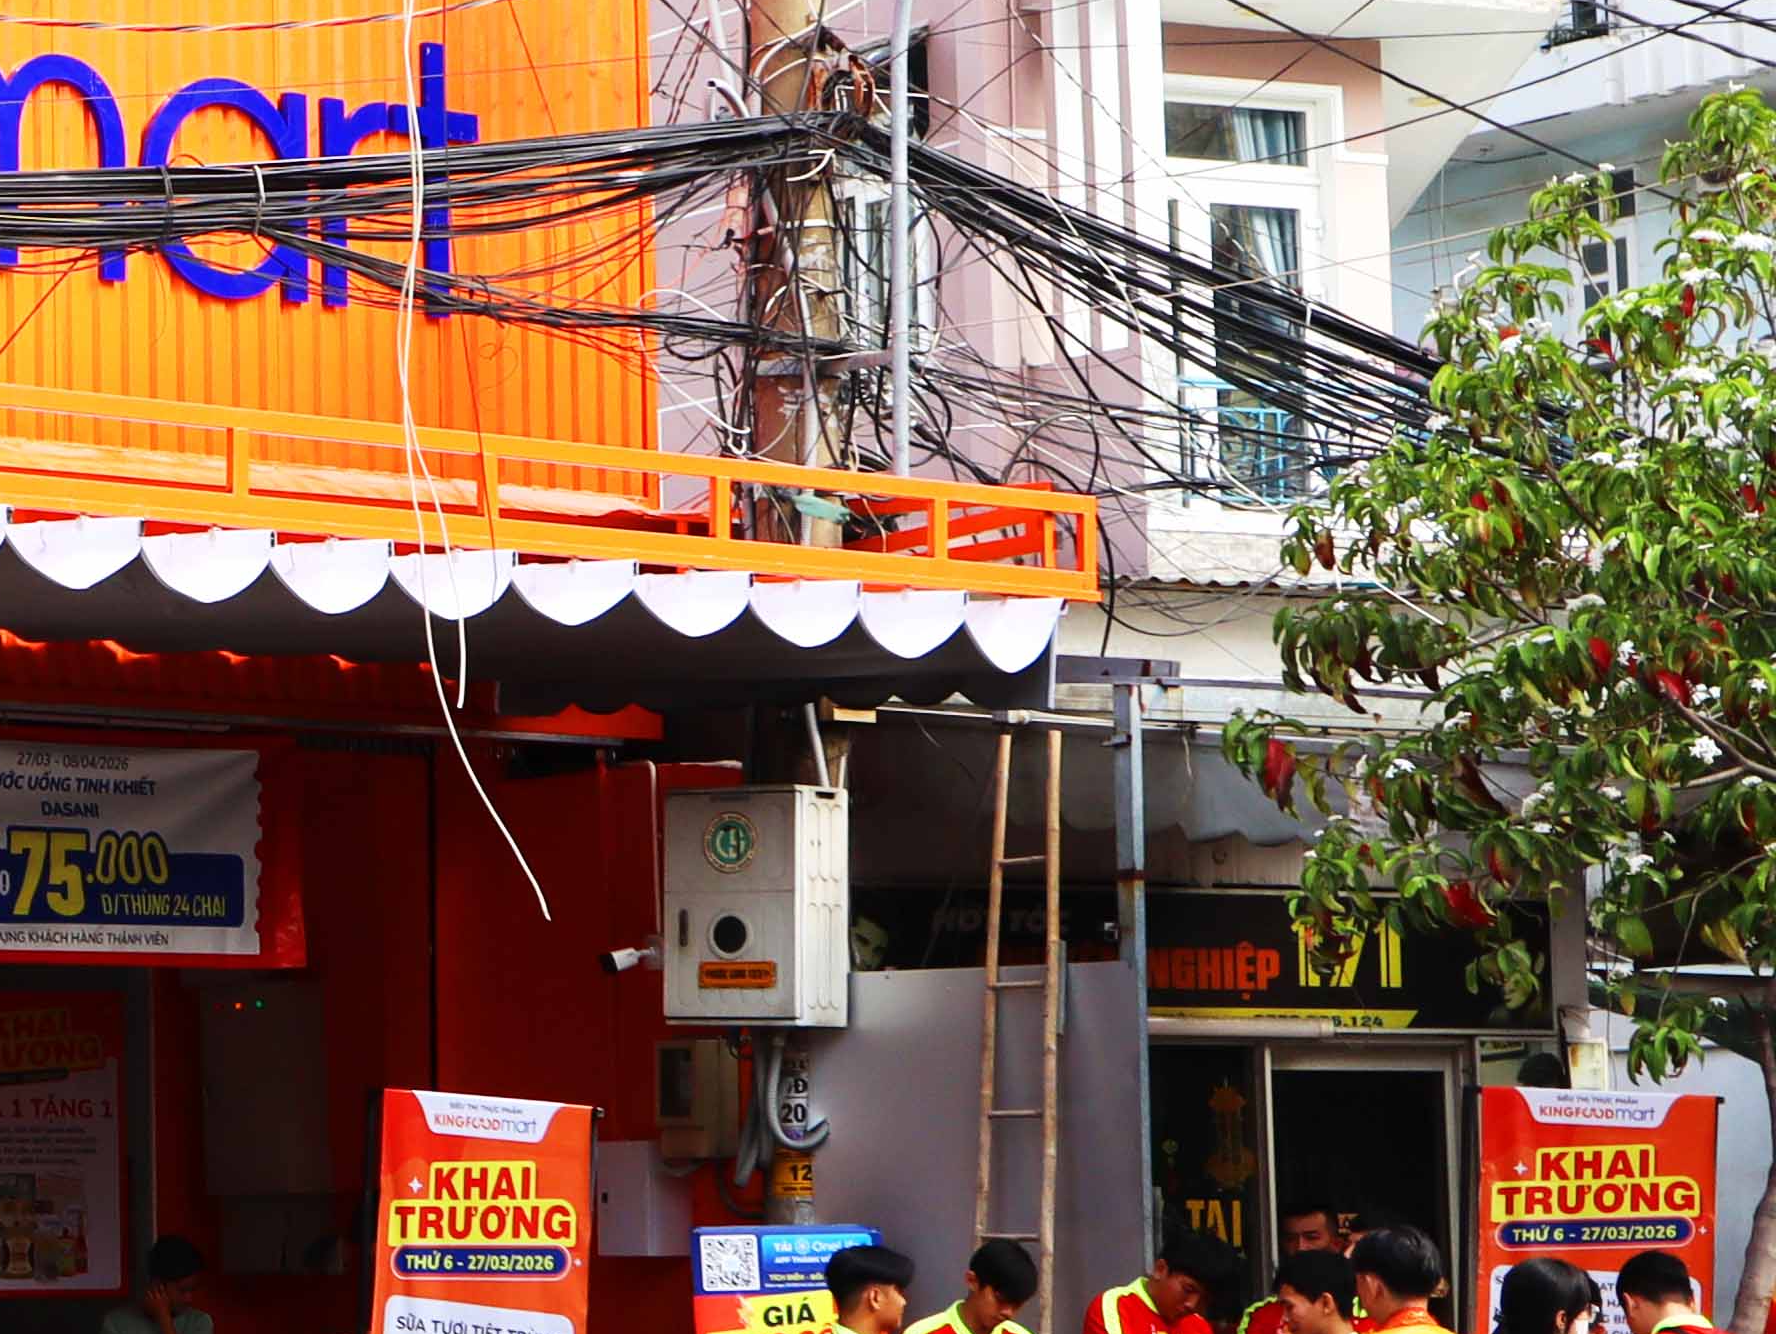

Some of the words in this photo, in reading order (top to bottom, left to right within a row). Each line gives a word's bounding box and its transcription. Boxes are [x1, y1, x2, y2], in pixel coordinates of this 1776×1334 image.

[17, 752, 51, 767] 27/03
[27, 770, 67, 794] UỐNG
[70, 776, 109, 795] TINH
[112, 773, 157, 797] KHIẾT
[41, 800, 101, 819] DASANI
[6, 828, 169, 917] 75.000
[173, 895, 190, 915] 24
[192, 896, 226, 918] CHAI
[31, 928, 68, 946] KHÁCH
[70, 928, 104, 946] HÀNG
[141, 930, 169, 947] VIÊN
[1148, 940, 1280, 1001] NGHIỆP
[12, 1099, 25, 1117] 1
[95, 1100, 113, 1117] 1
[782, 1103, 806, 1123] 20
[1539, 1104, 1656, 1124] KINGFOODmart
[434, 1114, 537, 1135] KINGFOODmart
[790, 1164, 813, 1180] 12
[1540, 1149, 1652, 1181] KHAI
[434, 1167, 532, 1201] KHAI
[1497, 1181, 1696, 1217] TRƯƠNG
[394, 1204, 572, 1241] TRƯƠNG
[1512, 1221, 1549, 1243] THỨ
[1553, 1229, 1564, 1243] 6
[1581, 1223, 1678, 1243] 27/03/2026
[405, 1249, 441, 1270] THỨ
[444, 1256, 454, 1270] 6
[467, 1255, 555, 1272] 27/03/2026
[396, 1313, 426, 1333] SỮA
[763, 1297, 815, 1327] GIÁ
